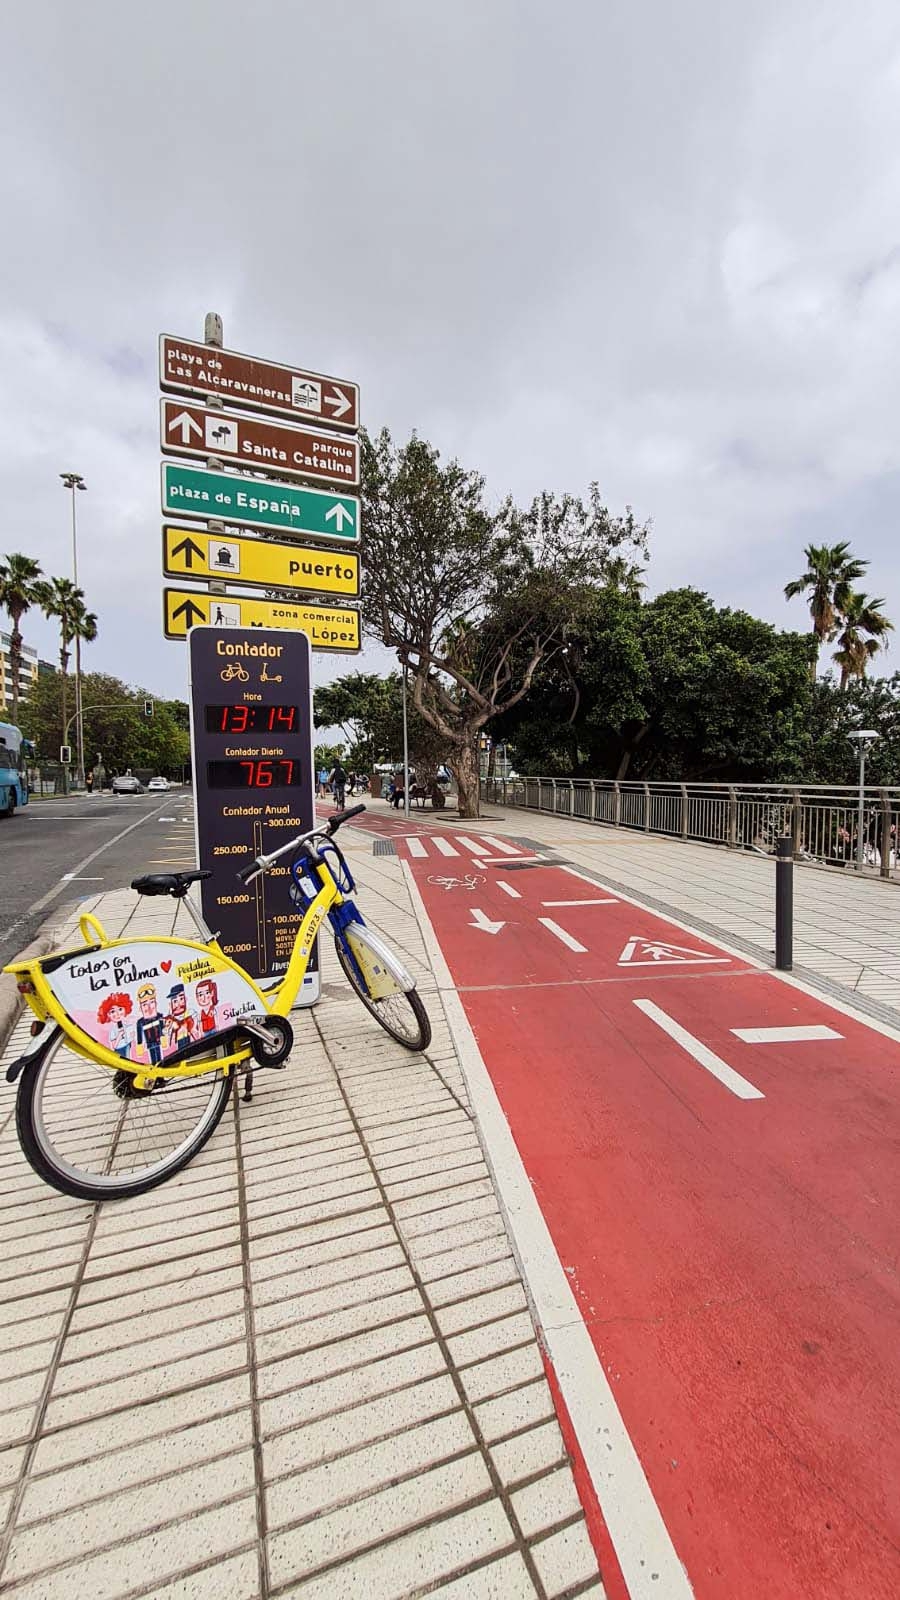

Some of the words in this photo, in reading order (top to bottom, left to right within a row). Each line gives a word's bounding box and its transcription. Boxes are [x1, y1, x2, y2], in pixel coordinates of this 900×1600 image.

[167, 349, 203, 366] playa
[207, 359, 223, 370] de
[167, 362, 192, 378] Las
[197, 372, 292, 402] Alcaravaneras
[242, 440, 287, 461] Santa
[293, 451, 353, 474] Catalina
[312, 442, 353, 459] parque
[169, 484, 209, 501] plaza
[214, 493, 232, 505] de
[236, 491, 301, 517] España
[289, 560, 354, 581] puerto
[272, 609, 298, 619] zona
[302, 611, 355, 624] comercial
[311, 626, 355, 642] López
[216, 640, 284, 658] Contador
[243, 692, 262, 701] Hora
[220, 704, 297, 733] 13:14
[225, 747, 260, 757] Contador
[261, 747, 284, 757] Diario
[239, 760, 294, 788] 767
[223, 806, 263, 817] Contador
[265, 804, 290, 815] Anual
[268, 818, 301, 828] 300.000
[213, 846, 248, 855] 250.000
[216, 895, 250, 904] 150.000
[272, 914, 304, 924] 100.000
[275, 928, 288, 936] POR
[288, 927, 297, 935] LA
[304, 912, 321, 945] 41073
[223, 943, 251, 954] 50.000
[275, 949, 285, 957] EN
[66, 959, 111, 979] todos
[88, 975, 111, 991] la
[113, 963, 160, 987] Palma
[186, 974, 193, 983] y
